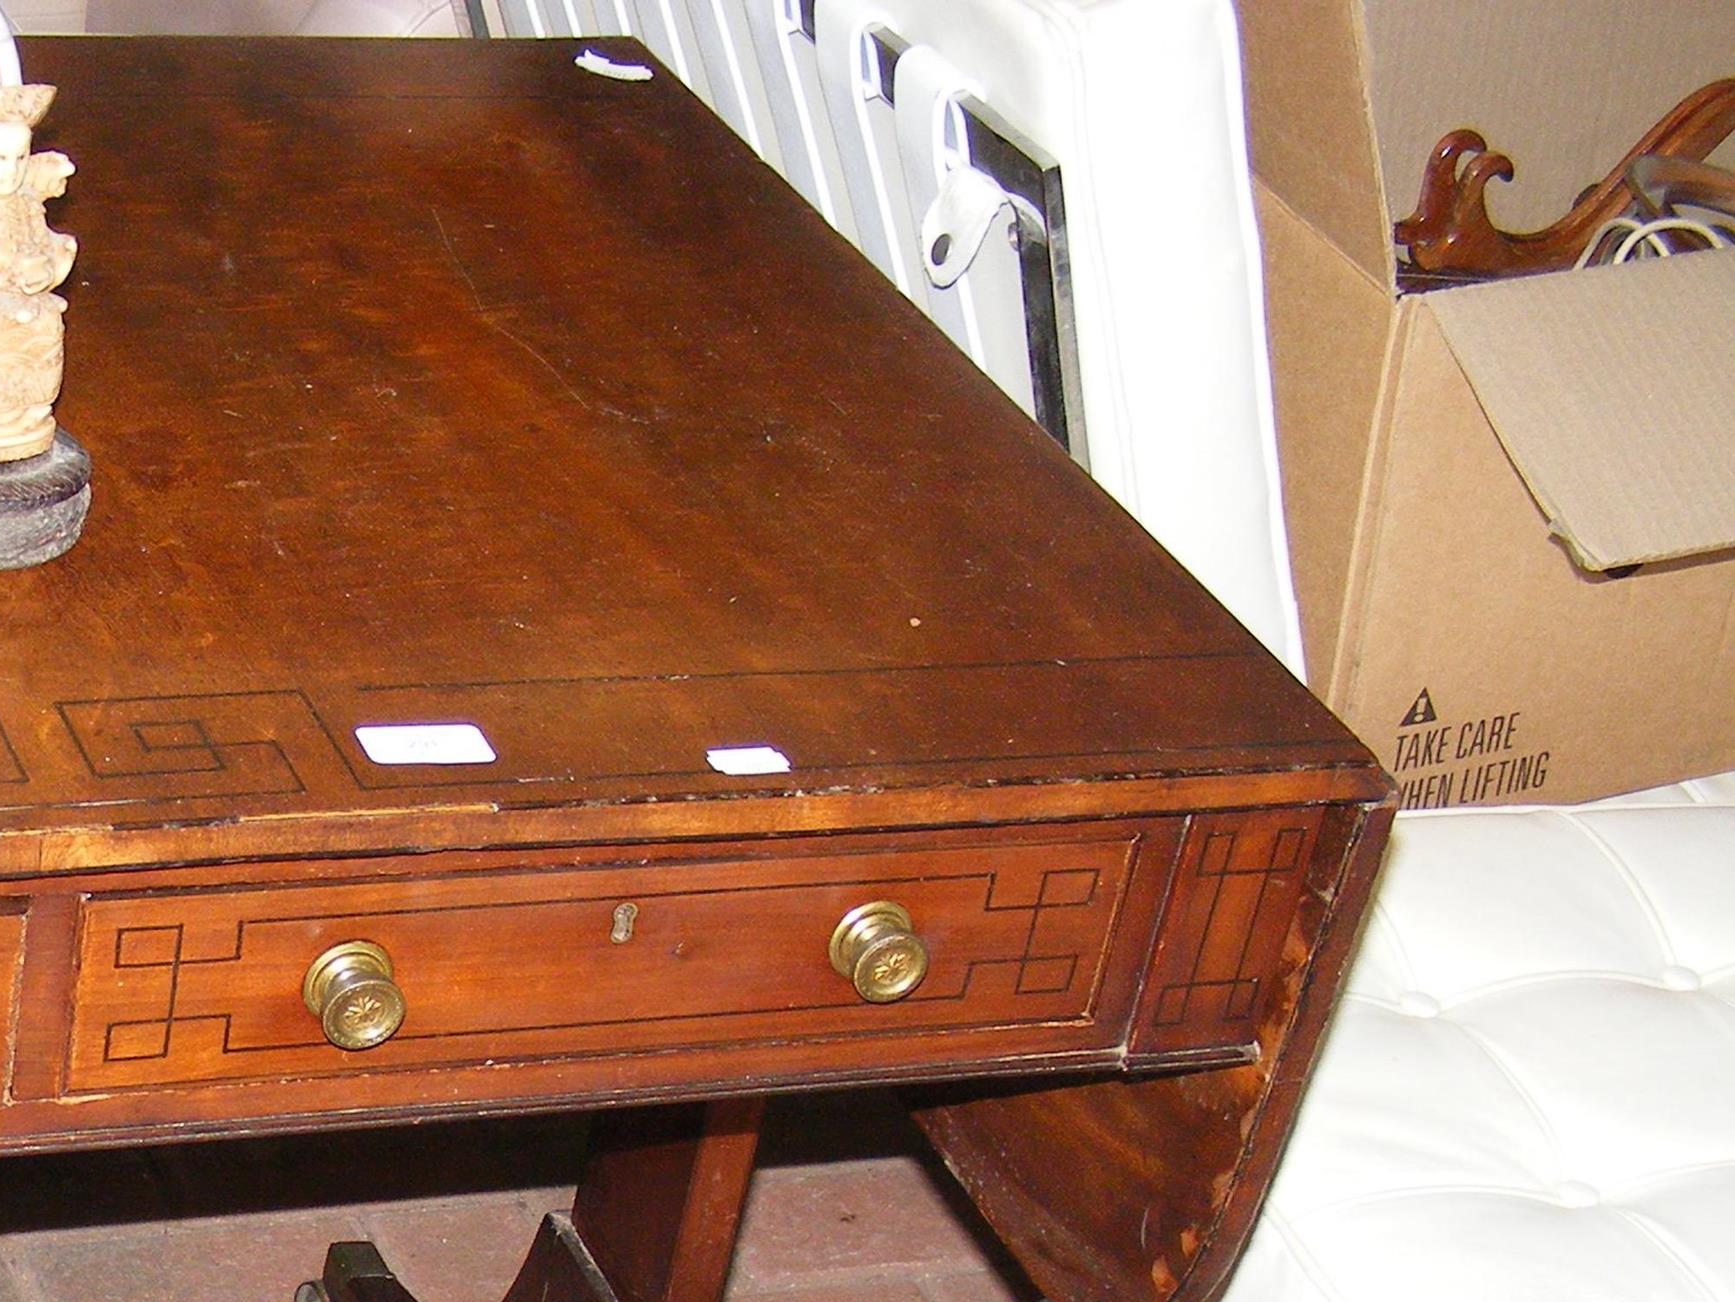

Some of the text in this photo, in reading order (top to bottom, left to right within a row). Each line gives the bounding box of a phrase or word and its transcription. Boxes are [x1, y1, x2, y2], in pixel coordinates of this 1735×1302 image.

[1394, 711, 1521, 772] TAKE CARE
[1459, 751, 1550, 804] LIFTING
